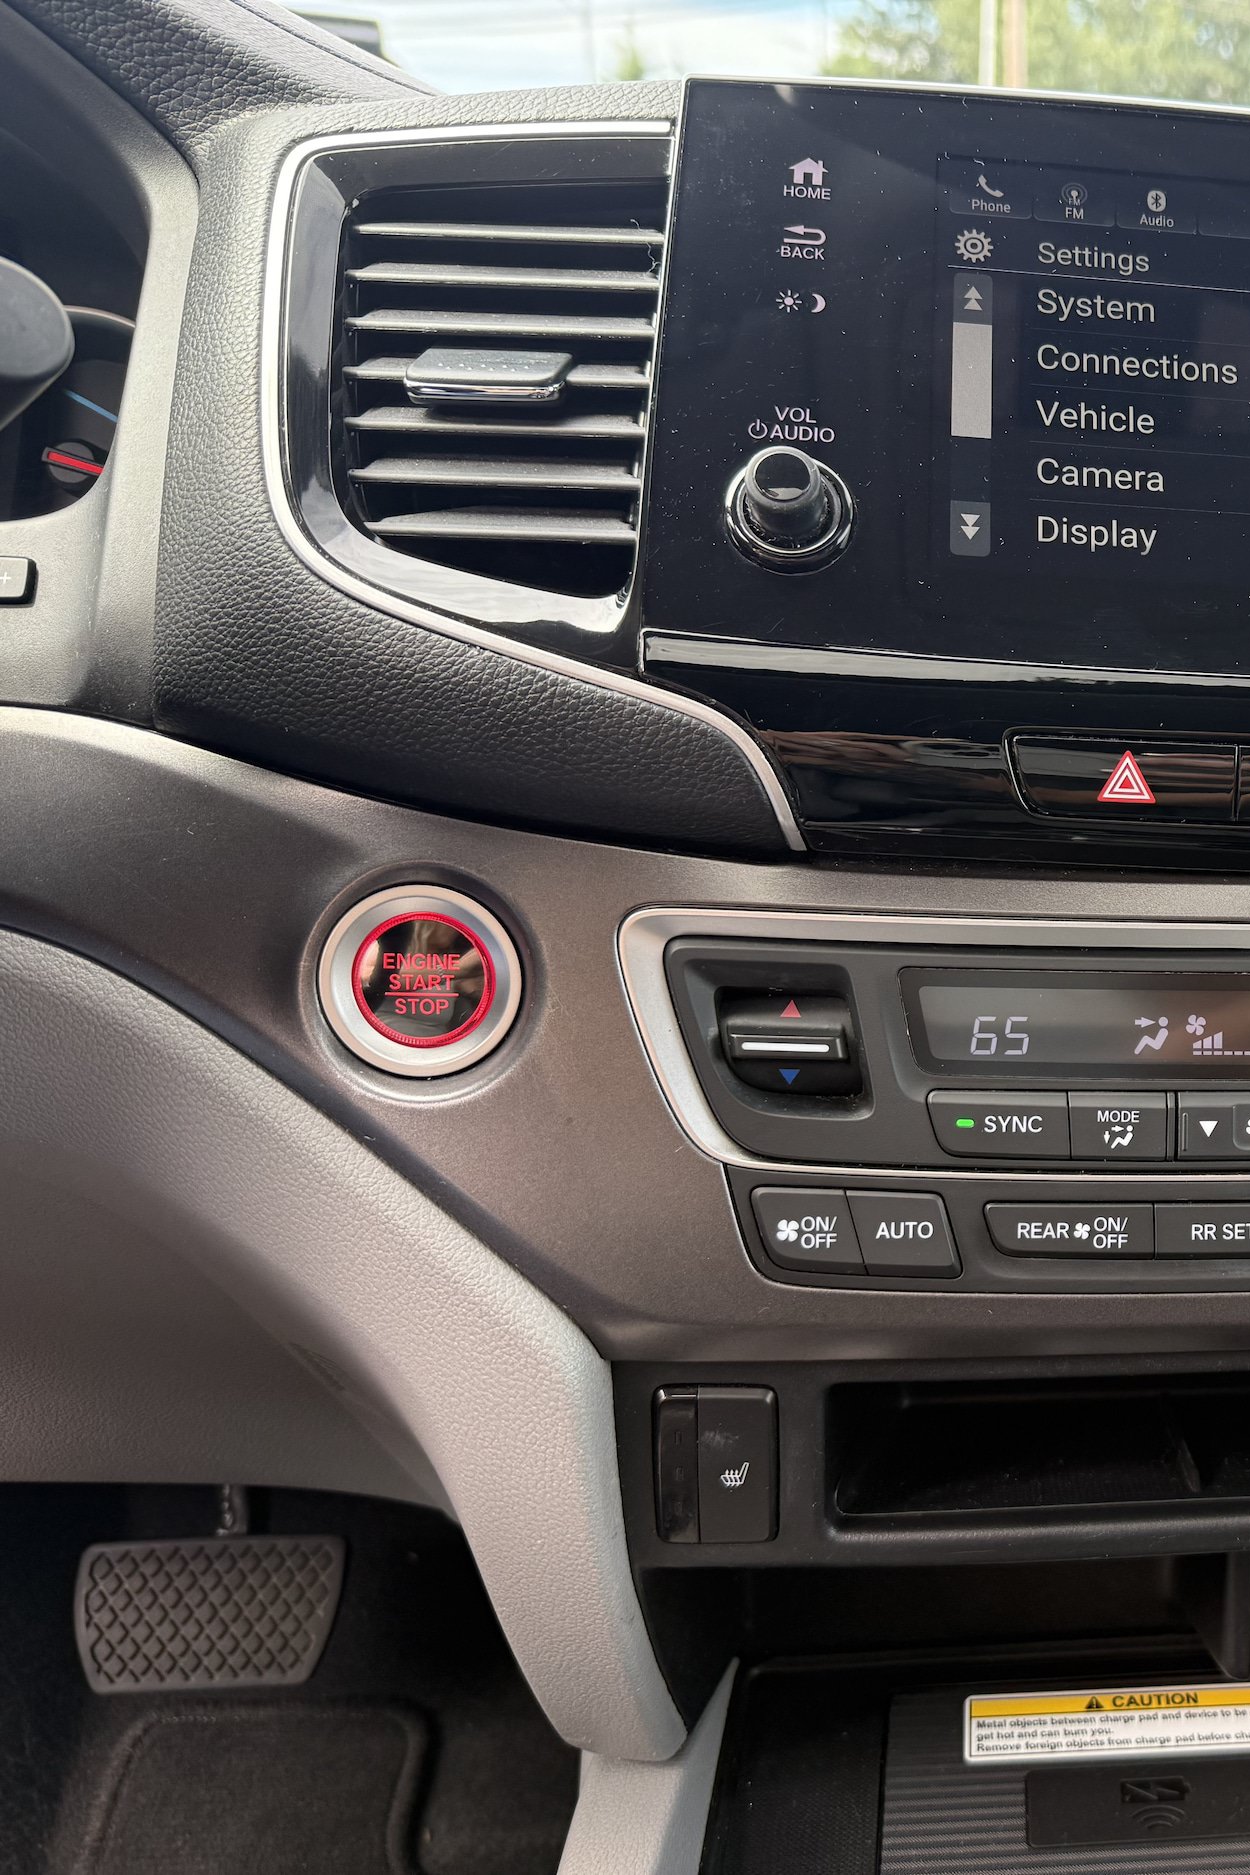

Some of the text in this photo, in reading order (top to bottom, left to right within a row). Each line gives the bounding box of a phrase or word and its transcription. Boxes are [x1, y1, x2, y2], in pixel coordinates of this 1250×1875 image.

[783, 185, 832, 200] HOME
[971, 199, 1011, 214] Phone
[1065, 207, 1084, 220] FM
[1139, 214, 1175, 228] Audio
[780, 245, 825, 260] BACK
[1037, 242, 1150, 276] Settings
[1036, 288, 1156, 323] System
[1036, 344, 1239, 385] Connections
[774, 406, 817, 424] VOL
[1035, 399, 1156, 434] Vehicle
[770, 425, 835, 443] AUDIO
[1036, 457, 1165, 492] Camera
[1036, 515, 1157, 556] Display
[383, 953, 461, 970] ENGINE
[389, 974, 455, 991] START
[395, 998, 449, 1015] STOP
[970, 1016, 1030, 1055] 65
[983, 1115, 1043, 1133] SYNC
[1097, 1110, 1140, 1123] MODE
[801, 1216, 837, 1231] ON/
[875, 1222, 934, 1239] AUTO
[1017, 1222, 1070, 1239] REAR
[1093, 1217, 1128, 1232] ON/
[1191, 1223, 1217, 1241] RR
[801, 1233, 837, 1249] OFF
[1092, 1234, 1128, 1249] OFF
[1111, 1691, 1199, 1708] CAUTION
[976, 1718, 1007, 1730] Metal
[1009, 1716, 1048, 1729] objects
[1050, 1715, 1096, 1727] between
[1099, 1713, 1135, 1725] charge
[1138, 1711, 1158, 1722] pad
[1161, 1710, 1181, 1721] and
[1184, 1708, 1219, 1720] device
[1220, 1708, 1232, 1718] to
[1234, 1706, 1247, 1716] be
[976, 1731, 994, 1743] get
[996, 1729, 1015, 1740] hot
[1017, 1728, 1038, 1739] and
[1040, 1728, 1060, 1738] can
[976, 1740, 1022, 1752] Remove
[1025, 1739, 1064, 1751] foreign
[1065, 1737, 1106, 1749] objects
[1107, 1736, 1134, 1746] from
[1135, 1734, 1172, 1745] charge
[1175, 1732, 1195, 1744] pad
[1197, 1729, 1231, 1742] before
